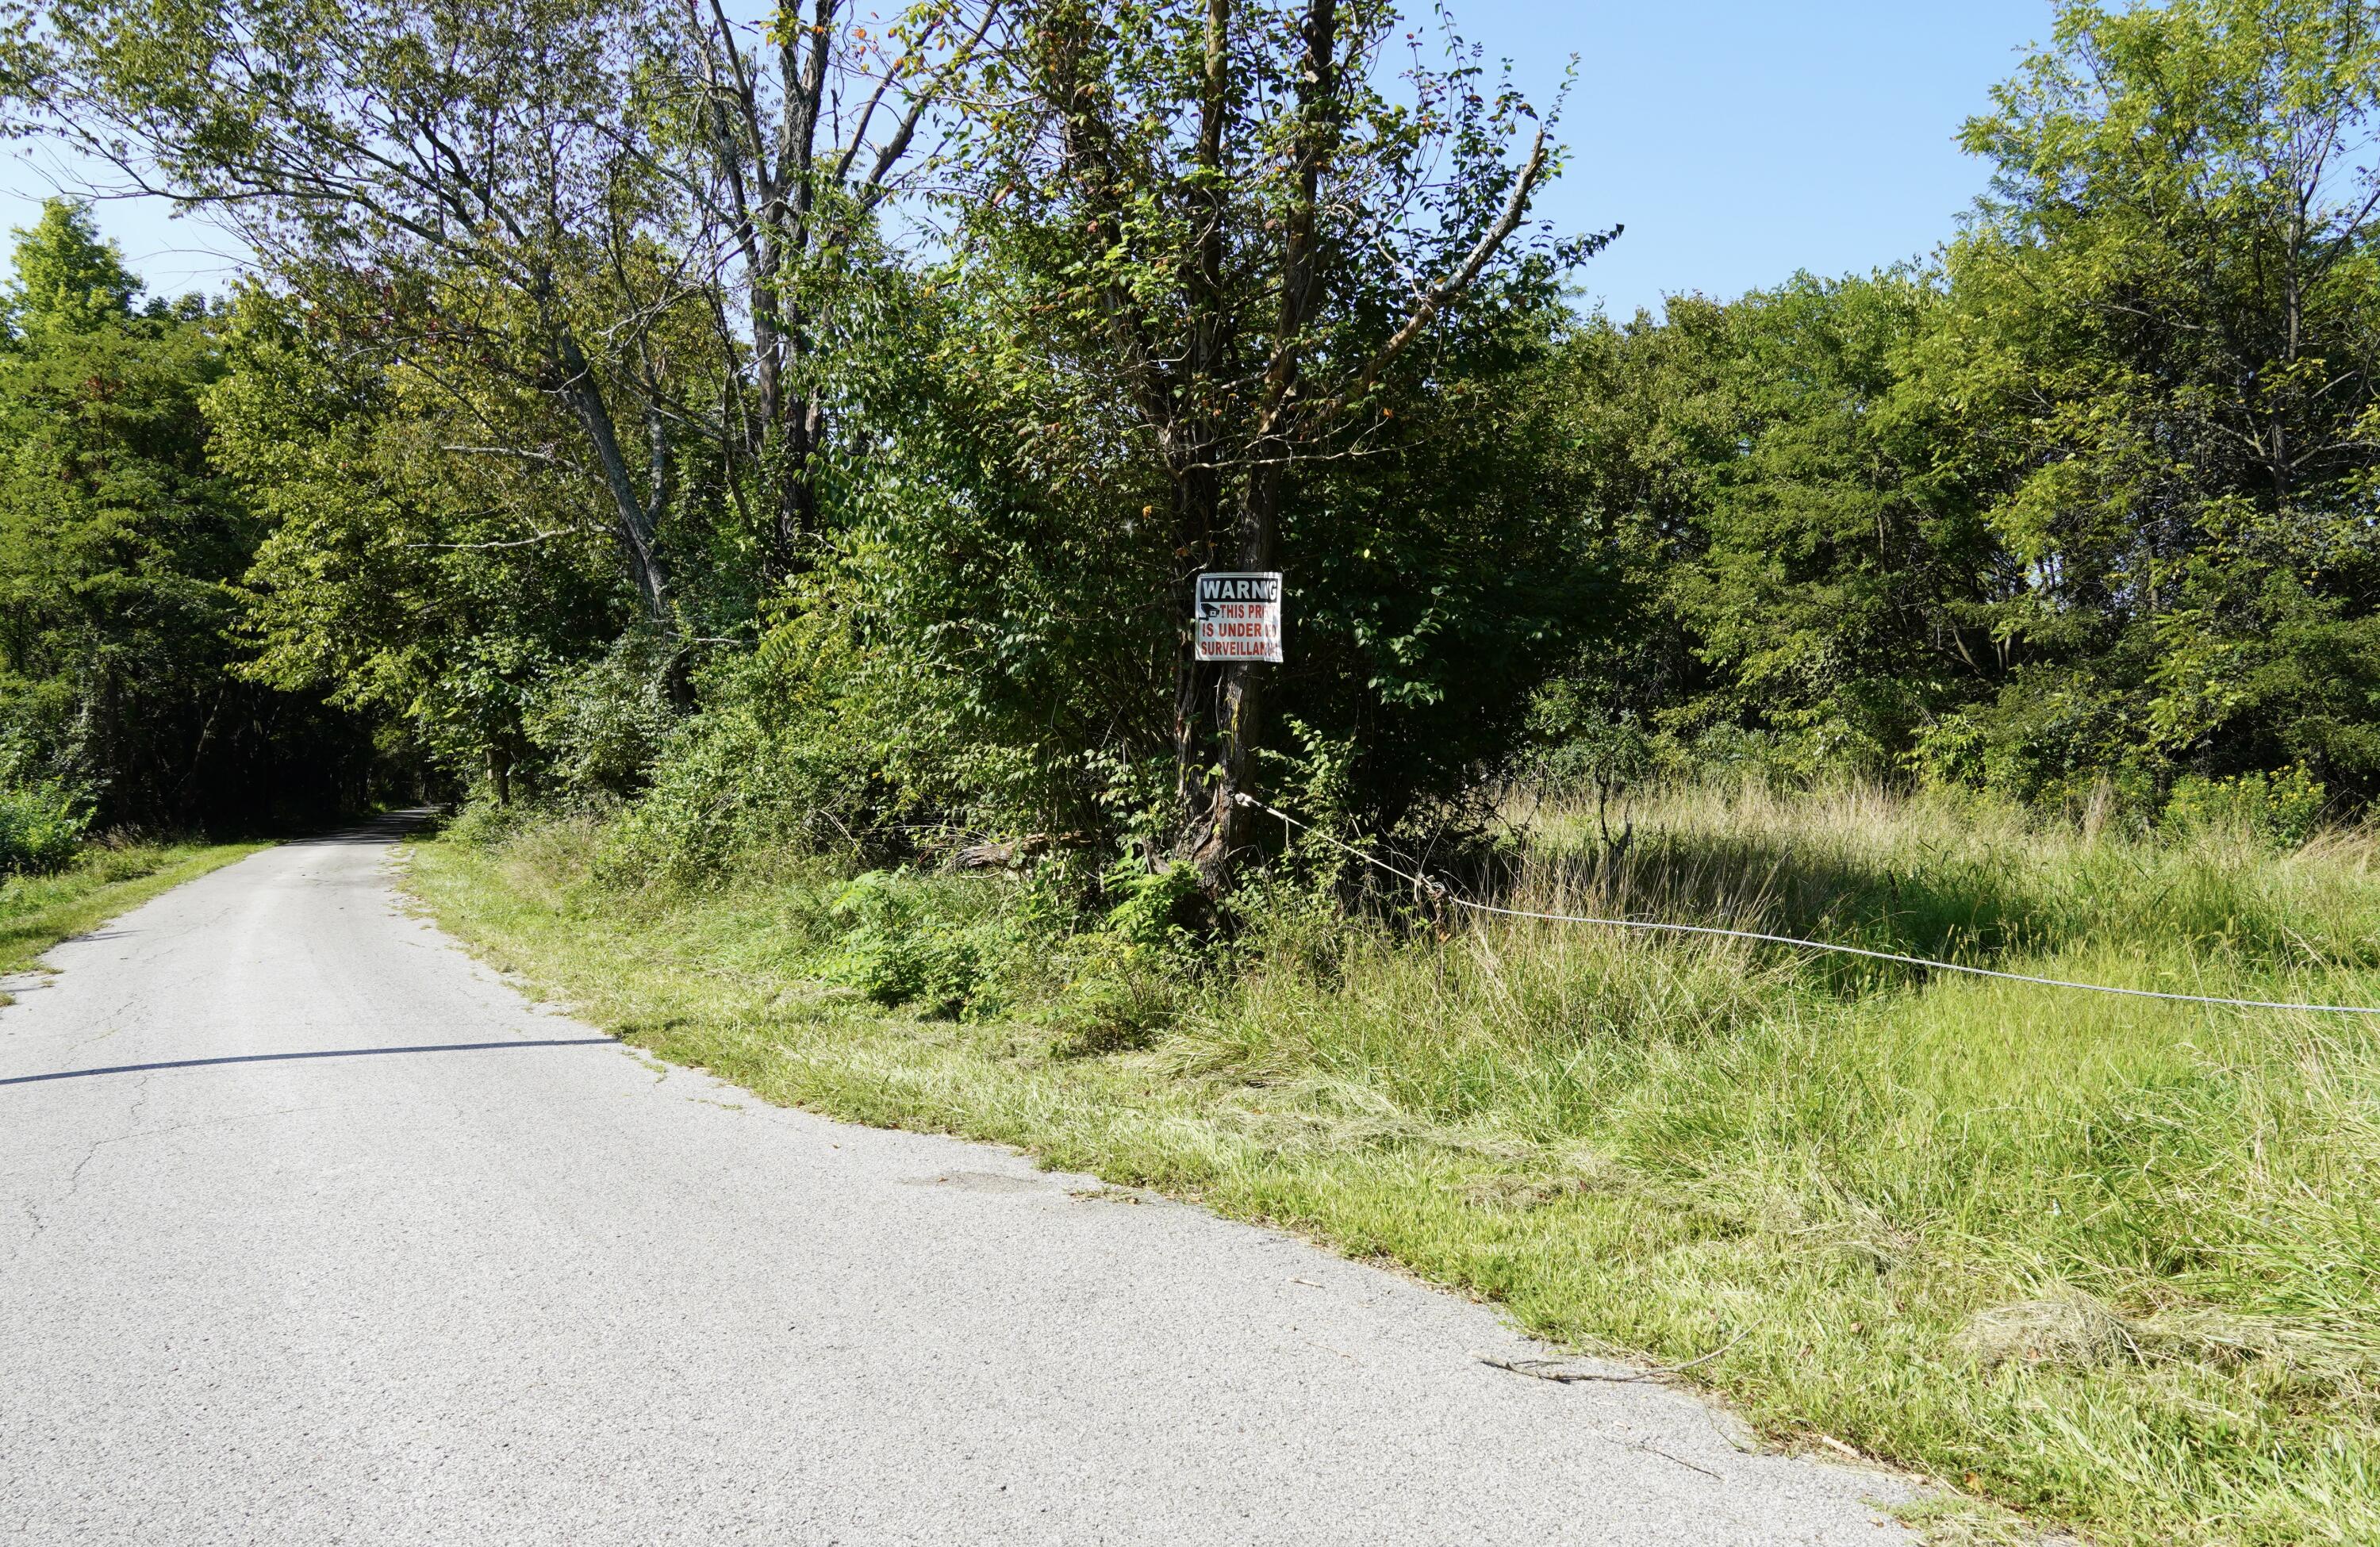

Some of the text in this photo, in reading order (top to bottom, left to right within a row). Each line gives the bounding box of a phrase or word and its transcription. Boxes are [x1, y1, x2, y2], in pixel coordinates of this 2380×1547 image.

[1219, 604, 1245, 619] THIS
[1202, 623, 1214, 637] IS
[1219, 623, 1262, 637] UNDER
[1200, 641, 1278, 656] SURVEILLAN
